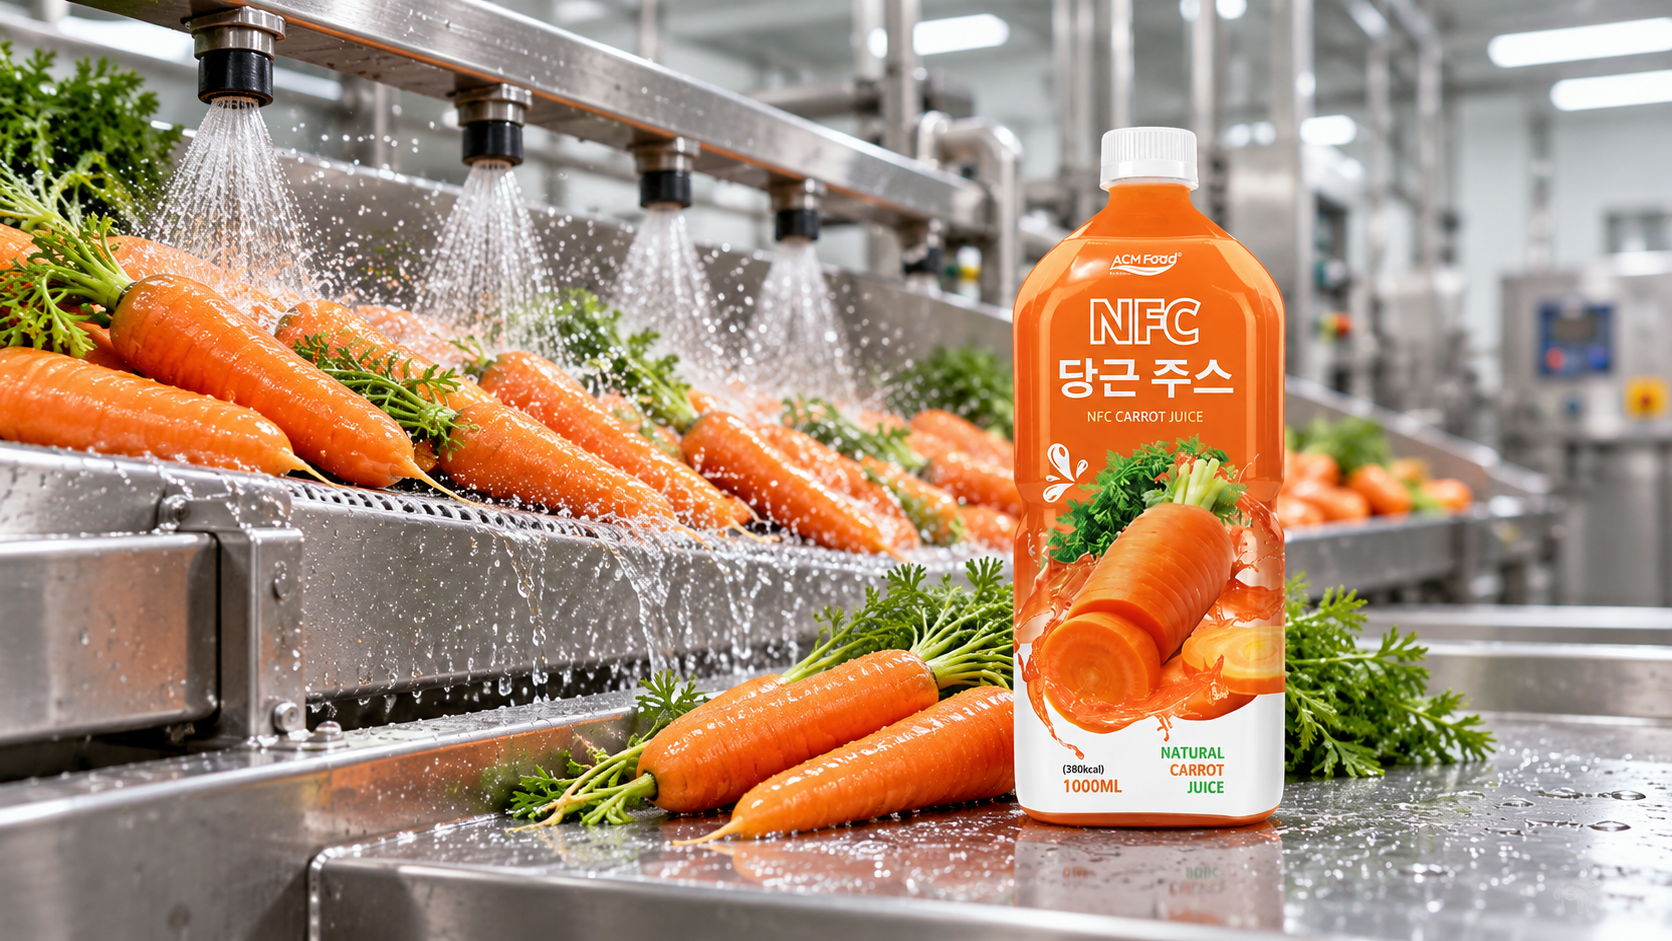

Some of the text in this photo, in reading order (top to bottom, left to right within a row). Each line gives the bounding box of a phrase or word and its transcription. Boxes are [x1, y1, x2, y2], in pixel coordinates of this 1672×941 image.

[1112, 253, 1142, 266] ACM
[1089, 297, 1202, 346] NFC
[1059, 357, 1234, 399] 당근 주스
[1087, 410, 1204, 423] NFC CARROT JUICE
[1161, 746, 1225, 760] NATURAL
[1062, 764, 1105, 776] (380kcal)
[1169, 763, 1225, 777] CARROT
[1063, 778, 1123, 794] 1000ML
[1186, 780, 1225, 794] JUICE
